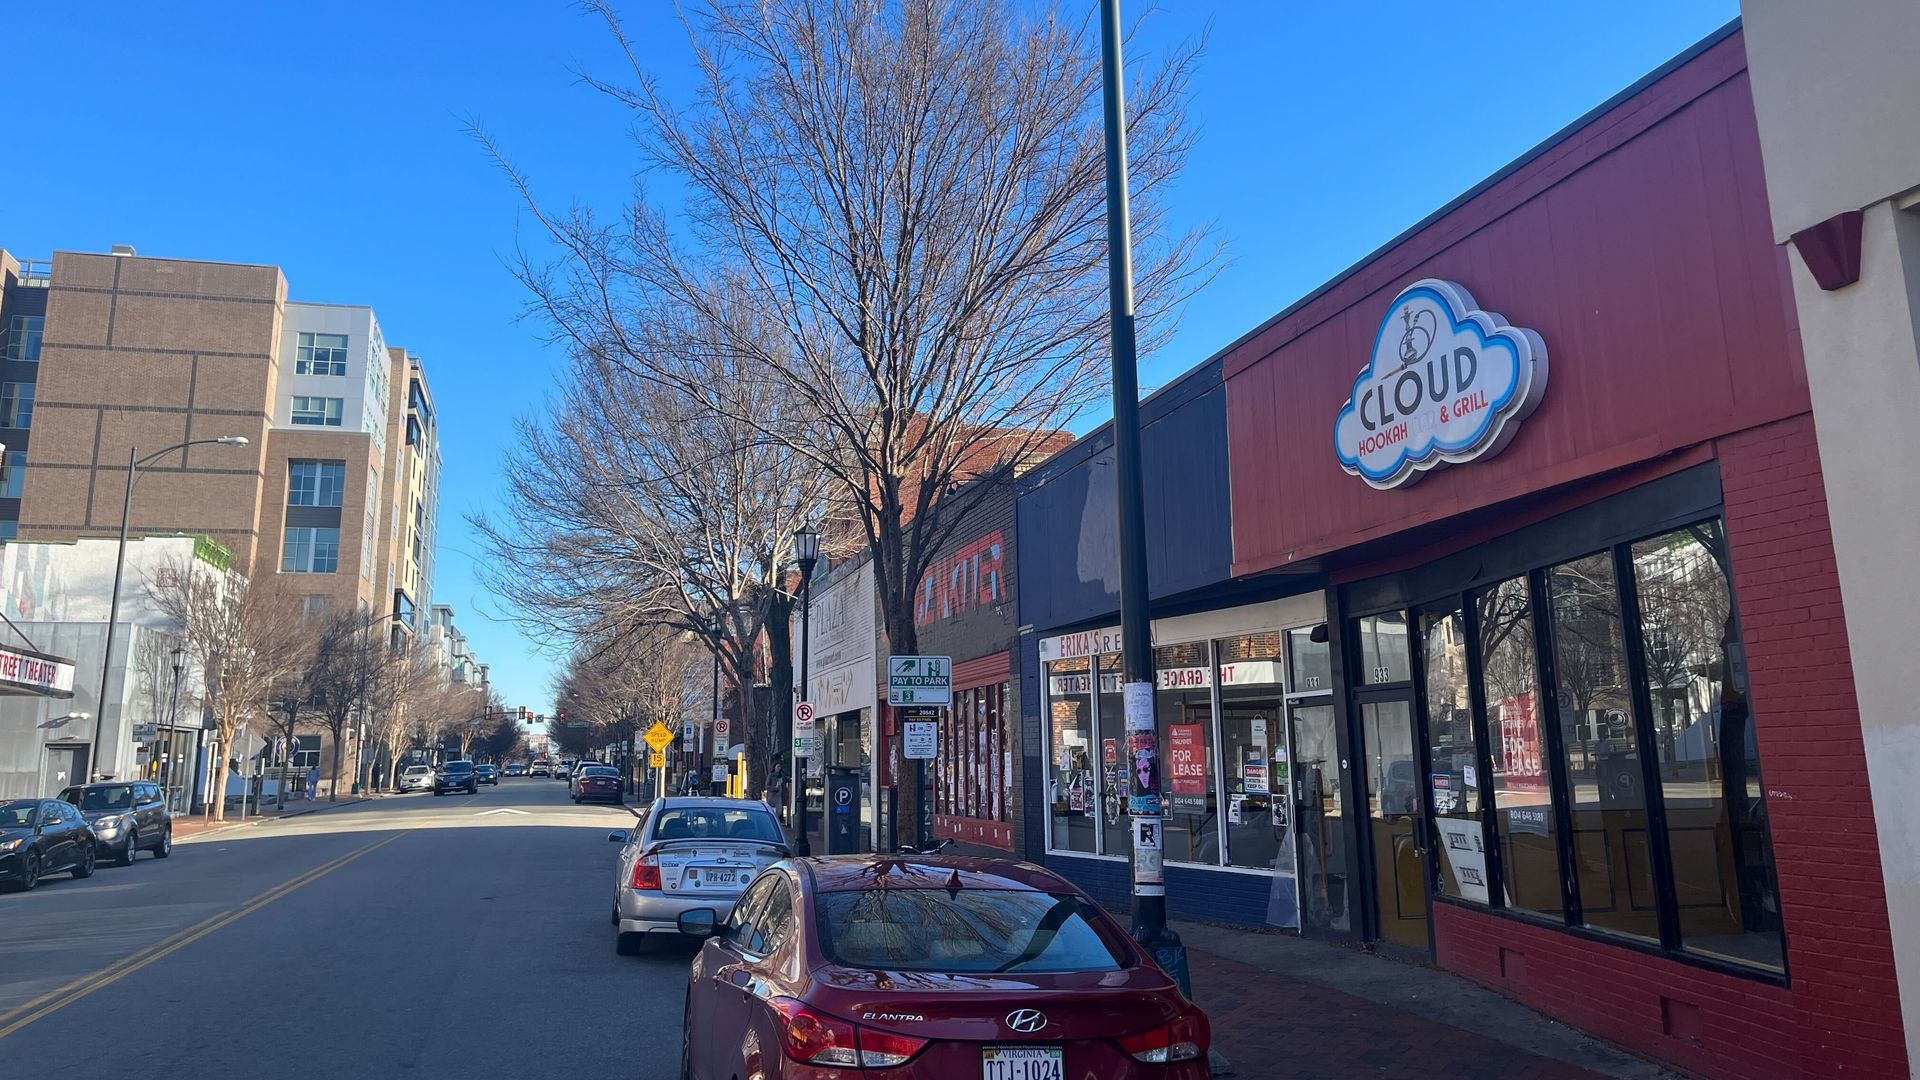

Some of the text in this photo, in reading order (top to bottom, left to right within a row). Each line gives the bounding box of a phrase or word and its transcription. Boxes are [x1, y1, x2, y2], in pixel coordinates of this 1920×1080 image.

[1360, 346, 1477, 431] CLOUD
[1358, 421, 1409, 457] HOOKAH
[1440, 405, 1449, 424] &
[1453, 390, 1489, 418] GRILL
[1060, 631, 1100, 658] ERIKA'S
[0, 654, 56, 684] TREET THEATER
[1374, 667, 1389, 683] 933
[892, 676, 948, 685] PAY TO PARK
[905, 692, 911, 700] 3
[795, 739, 800, 747] 3
[1503, 737, 1525, 756] FOR
[653, 754, 663, 762] 15
[1172, 750, 1191, 762] FOR
[1173, 764, 1203, 776] LEASE
[1505, 758, 1540, 777] LEASE
[862, 1012, 925, 1022] ELANTRA
[1002, 1050, 1043, 1059] VIRGINIA
[986, 1060, 1061, 1080] TTJ-1024
